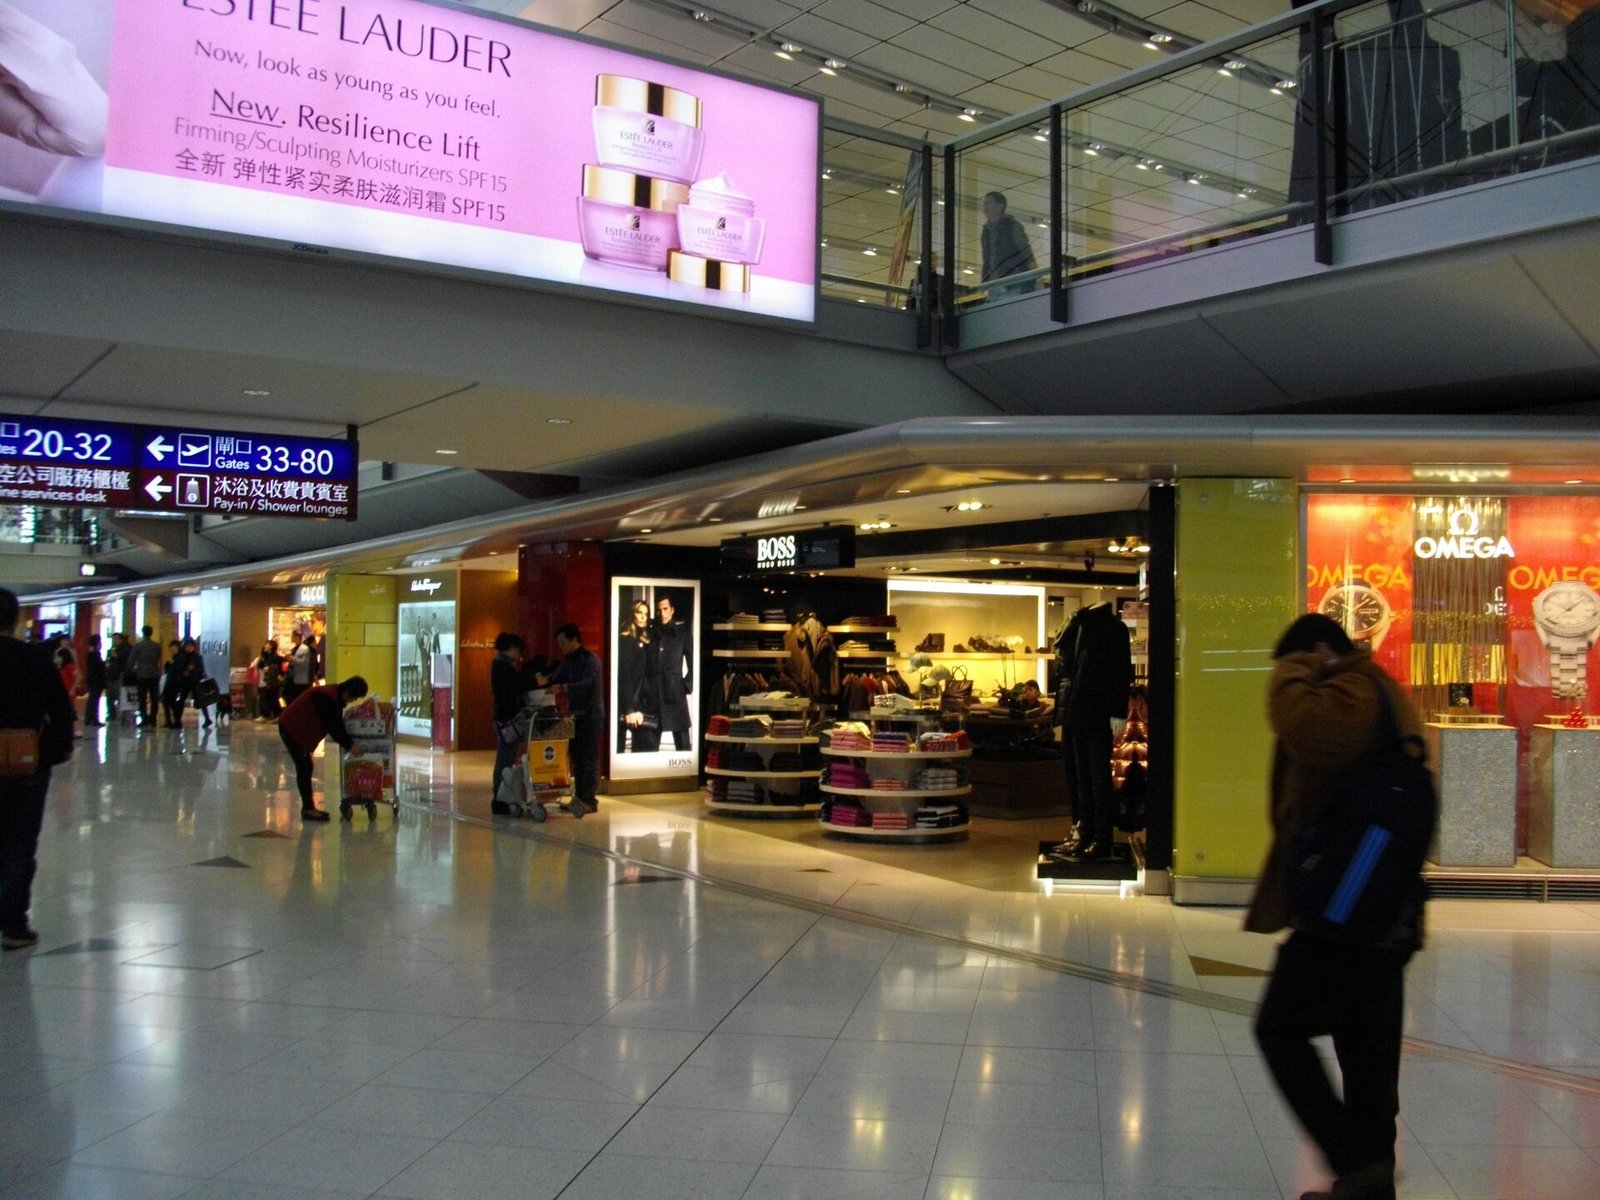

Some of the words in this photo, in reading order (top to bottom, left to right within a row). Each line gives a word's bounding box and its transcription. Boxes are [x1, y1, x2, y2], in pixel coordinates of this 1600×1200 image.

[182, 0, 320, 36] TEE
[339, 5, 512, 78] LAUDER
[195, 39, 249, 69] Now,
[257, 50, 301, 77] look
[307, 66, 328, 82] as
[334, 72, 394, 101] young
[399, 86, 419, 101] as
[425, 91, 458, 109] you
[464, 94, 501, 118] feel.
[210, 87, 287, 127] New.
[298, 104, 433, 152] Resilience
[443, 132, 481, 162] Lift
[174, 116, 341, 169] Firming/Sculpting
[346, 148, 454, 184] Moisturizers
[175, 148, 226, 178] 全新
[233, 156, 447, 214] 弹性紧实柔肤滋润霜
[22, 428, 112, 461] 20-32
[215, 436, 252, 456] 閘口
[215, 456, 250, 470] Gates
[256, 445, 333, 475] 33-80
[21, 488, 74, 501] services
[74, 489, 107, 502] desk
[213, 476, 349, 502] 沐浴及收費貴賓室
[213, 496, 248, 512] Pay-in
[258, 499, 301, 513] Shower
[303, 501, 348, 517] lounges
[757, 535, 796, 561] BOSS
[1414, 536, 1515, 559] OMEGA
[301, 585, 325, 602] GUCCI
[668, 758, 692, 767] BOSS
